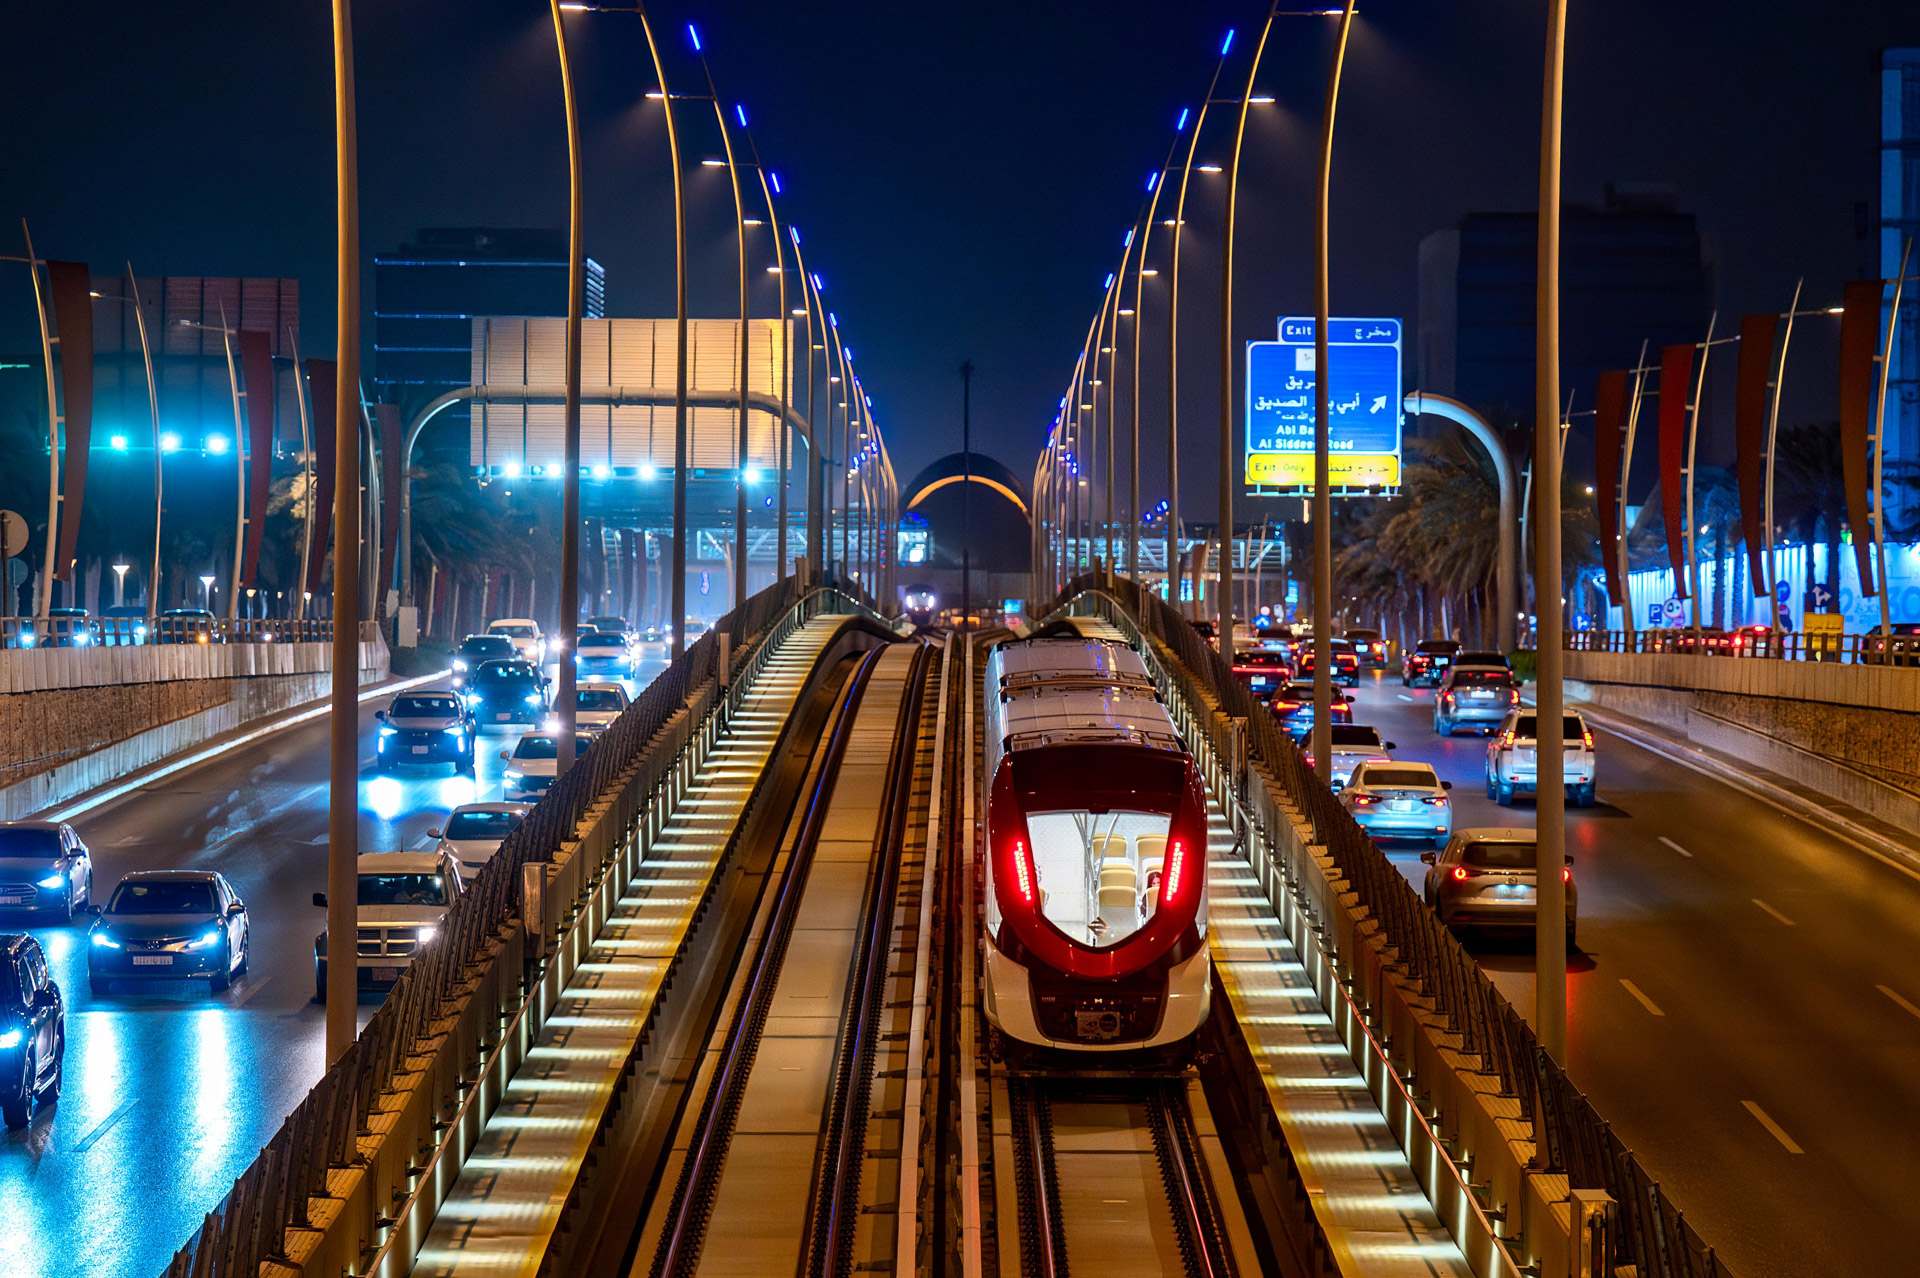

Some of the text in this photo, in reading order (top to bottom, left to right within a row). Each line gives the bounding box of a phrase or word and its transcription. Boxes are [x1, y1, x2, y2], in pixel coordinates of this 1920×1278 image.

[1286, 325, 1312, 336] Exit
[1354, 326, 1392, 340] مخرج
[1285, 375, 1316, 390] ريق
[1254, 395, 1308, 411] الصديق
[1336, 392, 1360, 415] أبي
[1275, 424, 1297, 435] Abi
[1275, 438, 1316, 449] Siddee
[1255, 462, 1306, 474] Exit Only
